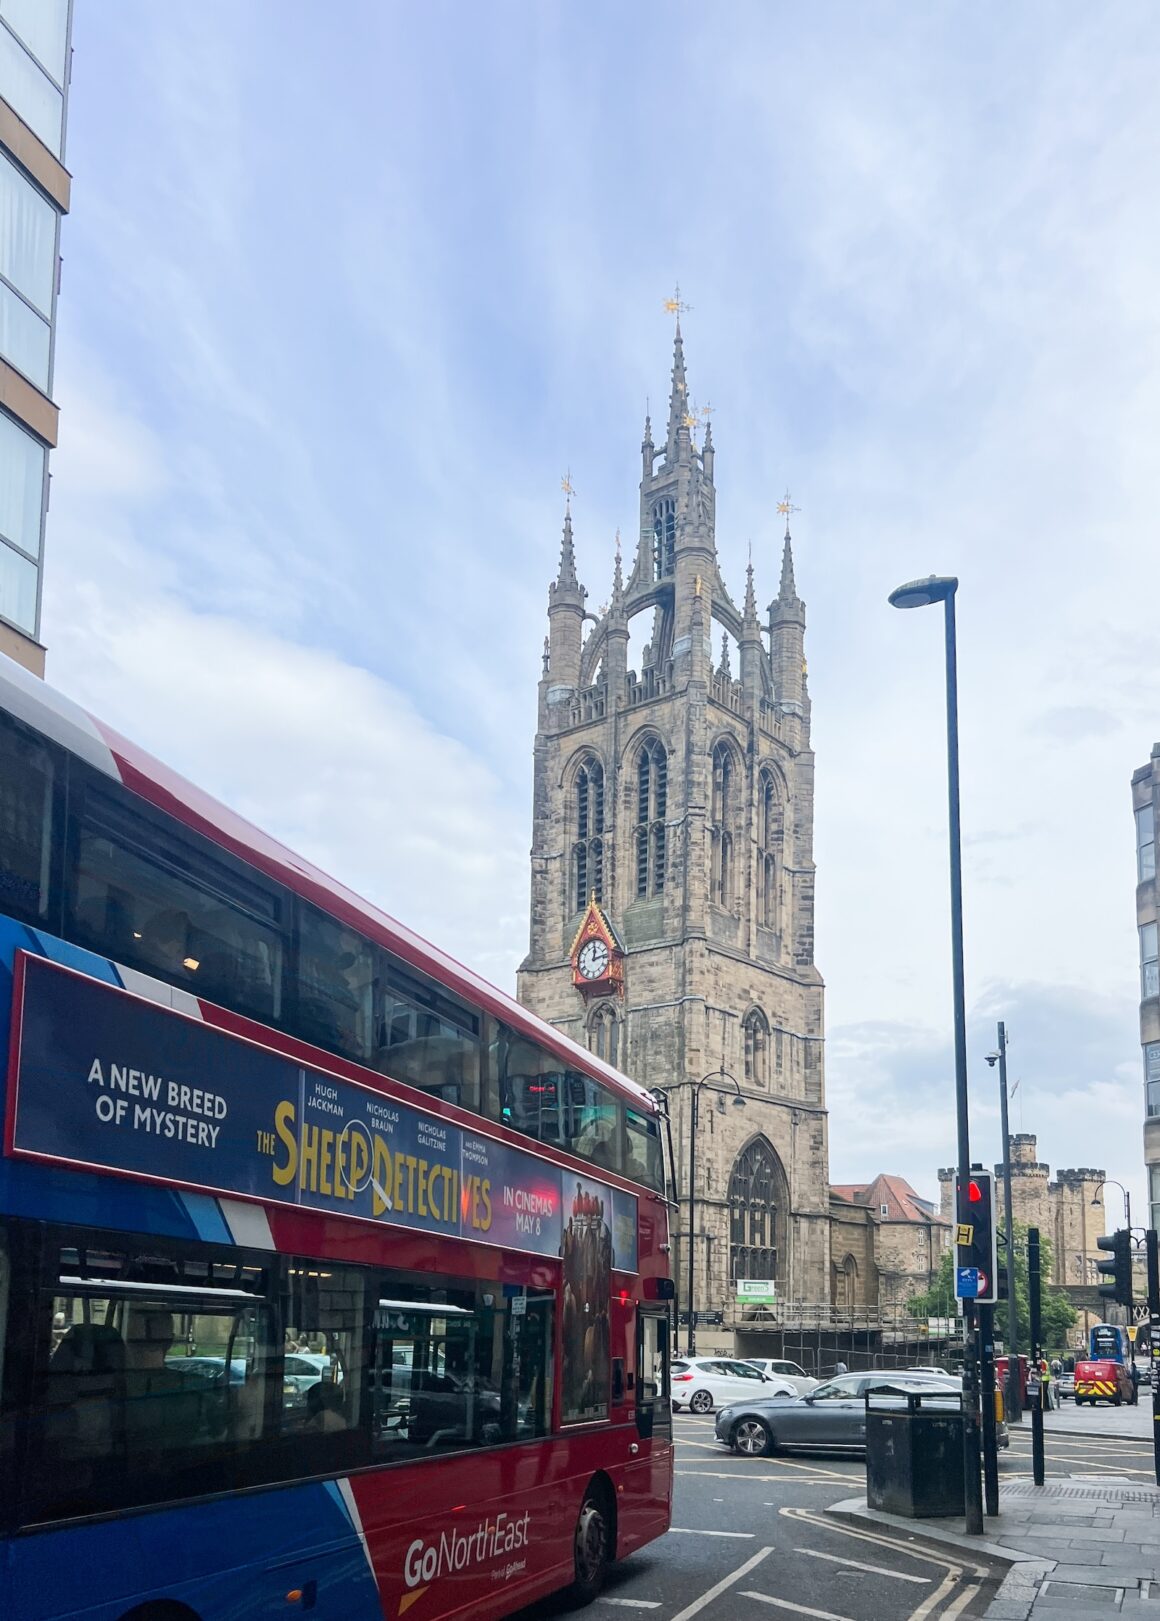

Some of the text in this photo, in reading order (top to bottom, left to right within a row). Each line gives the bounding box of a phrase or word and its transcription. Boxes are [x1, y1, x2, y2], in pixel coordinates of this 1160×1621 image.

[88, 1058, 227, 1119] A NEW BREED
[315, 1083, 338, 1100] HUGH
[307, 1096, 344, 1117] JACKMAN
[366, 1102, 399, 1122] NICHOLAS
[96, 1094, 220, 1148] OF MYSTERY
[371, 1118, 394, 1133] BRAUN
[418, 1122, 446, 1139] NICHOLAS
[257, 1130, 275, 1155] THE
[417, 1134, 446, 1152] GALITZINE
[472, 1141, 486, 1153] EMMA
[462, 1149, 488, 1166] THOMPSON
[503, 1185, 553, 1217] IN CINEMAS
[516, 1214, 541, 1236] MAY 8
